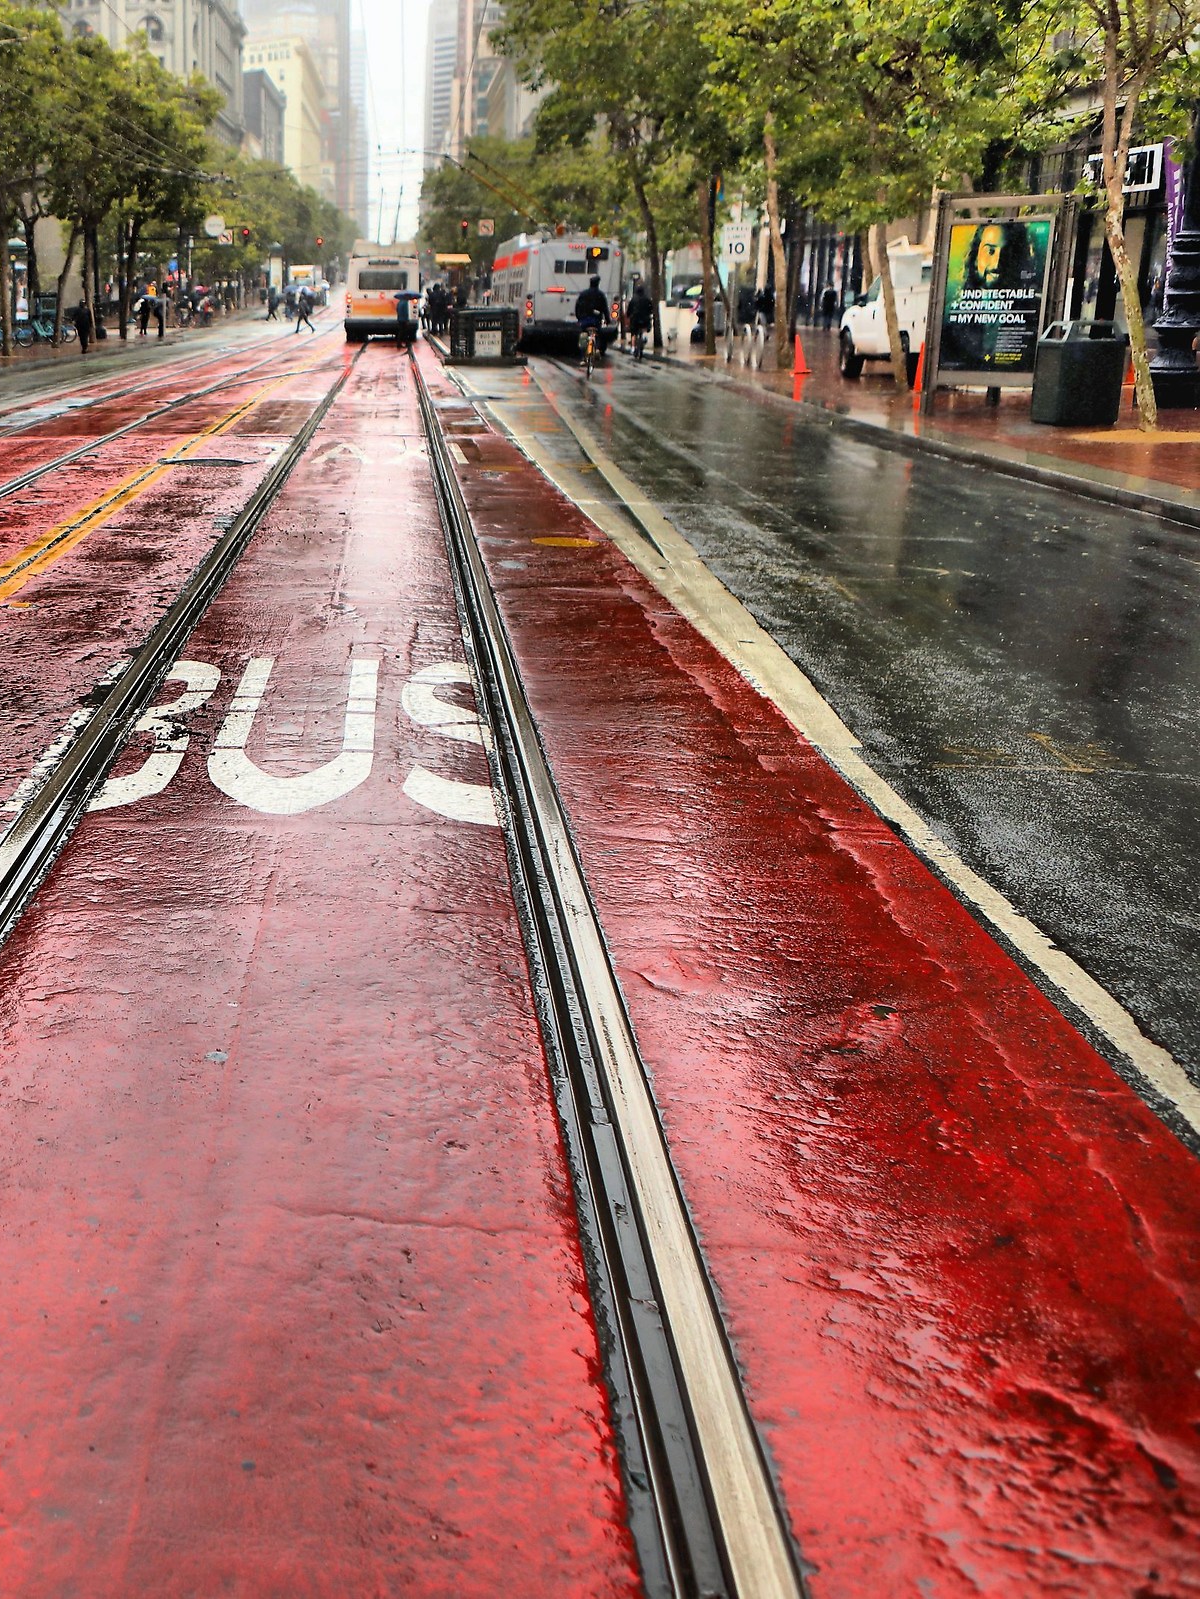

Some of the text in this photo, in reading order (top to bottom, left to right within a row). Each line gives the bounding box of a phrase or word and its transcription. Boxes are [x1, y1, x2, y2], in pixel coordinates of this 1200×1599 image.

[729, 242, 744, 254] 10
[960, 289, 1035, 299] UNDETECTABLE
[974, 313, 998, 323] NEW
[999, 313, 1026, 323] GOAL
[3, 660, 504, 827] BUS
